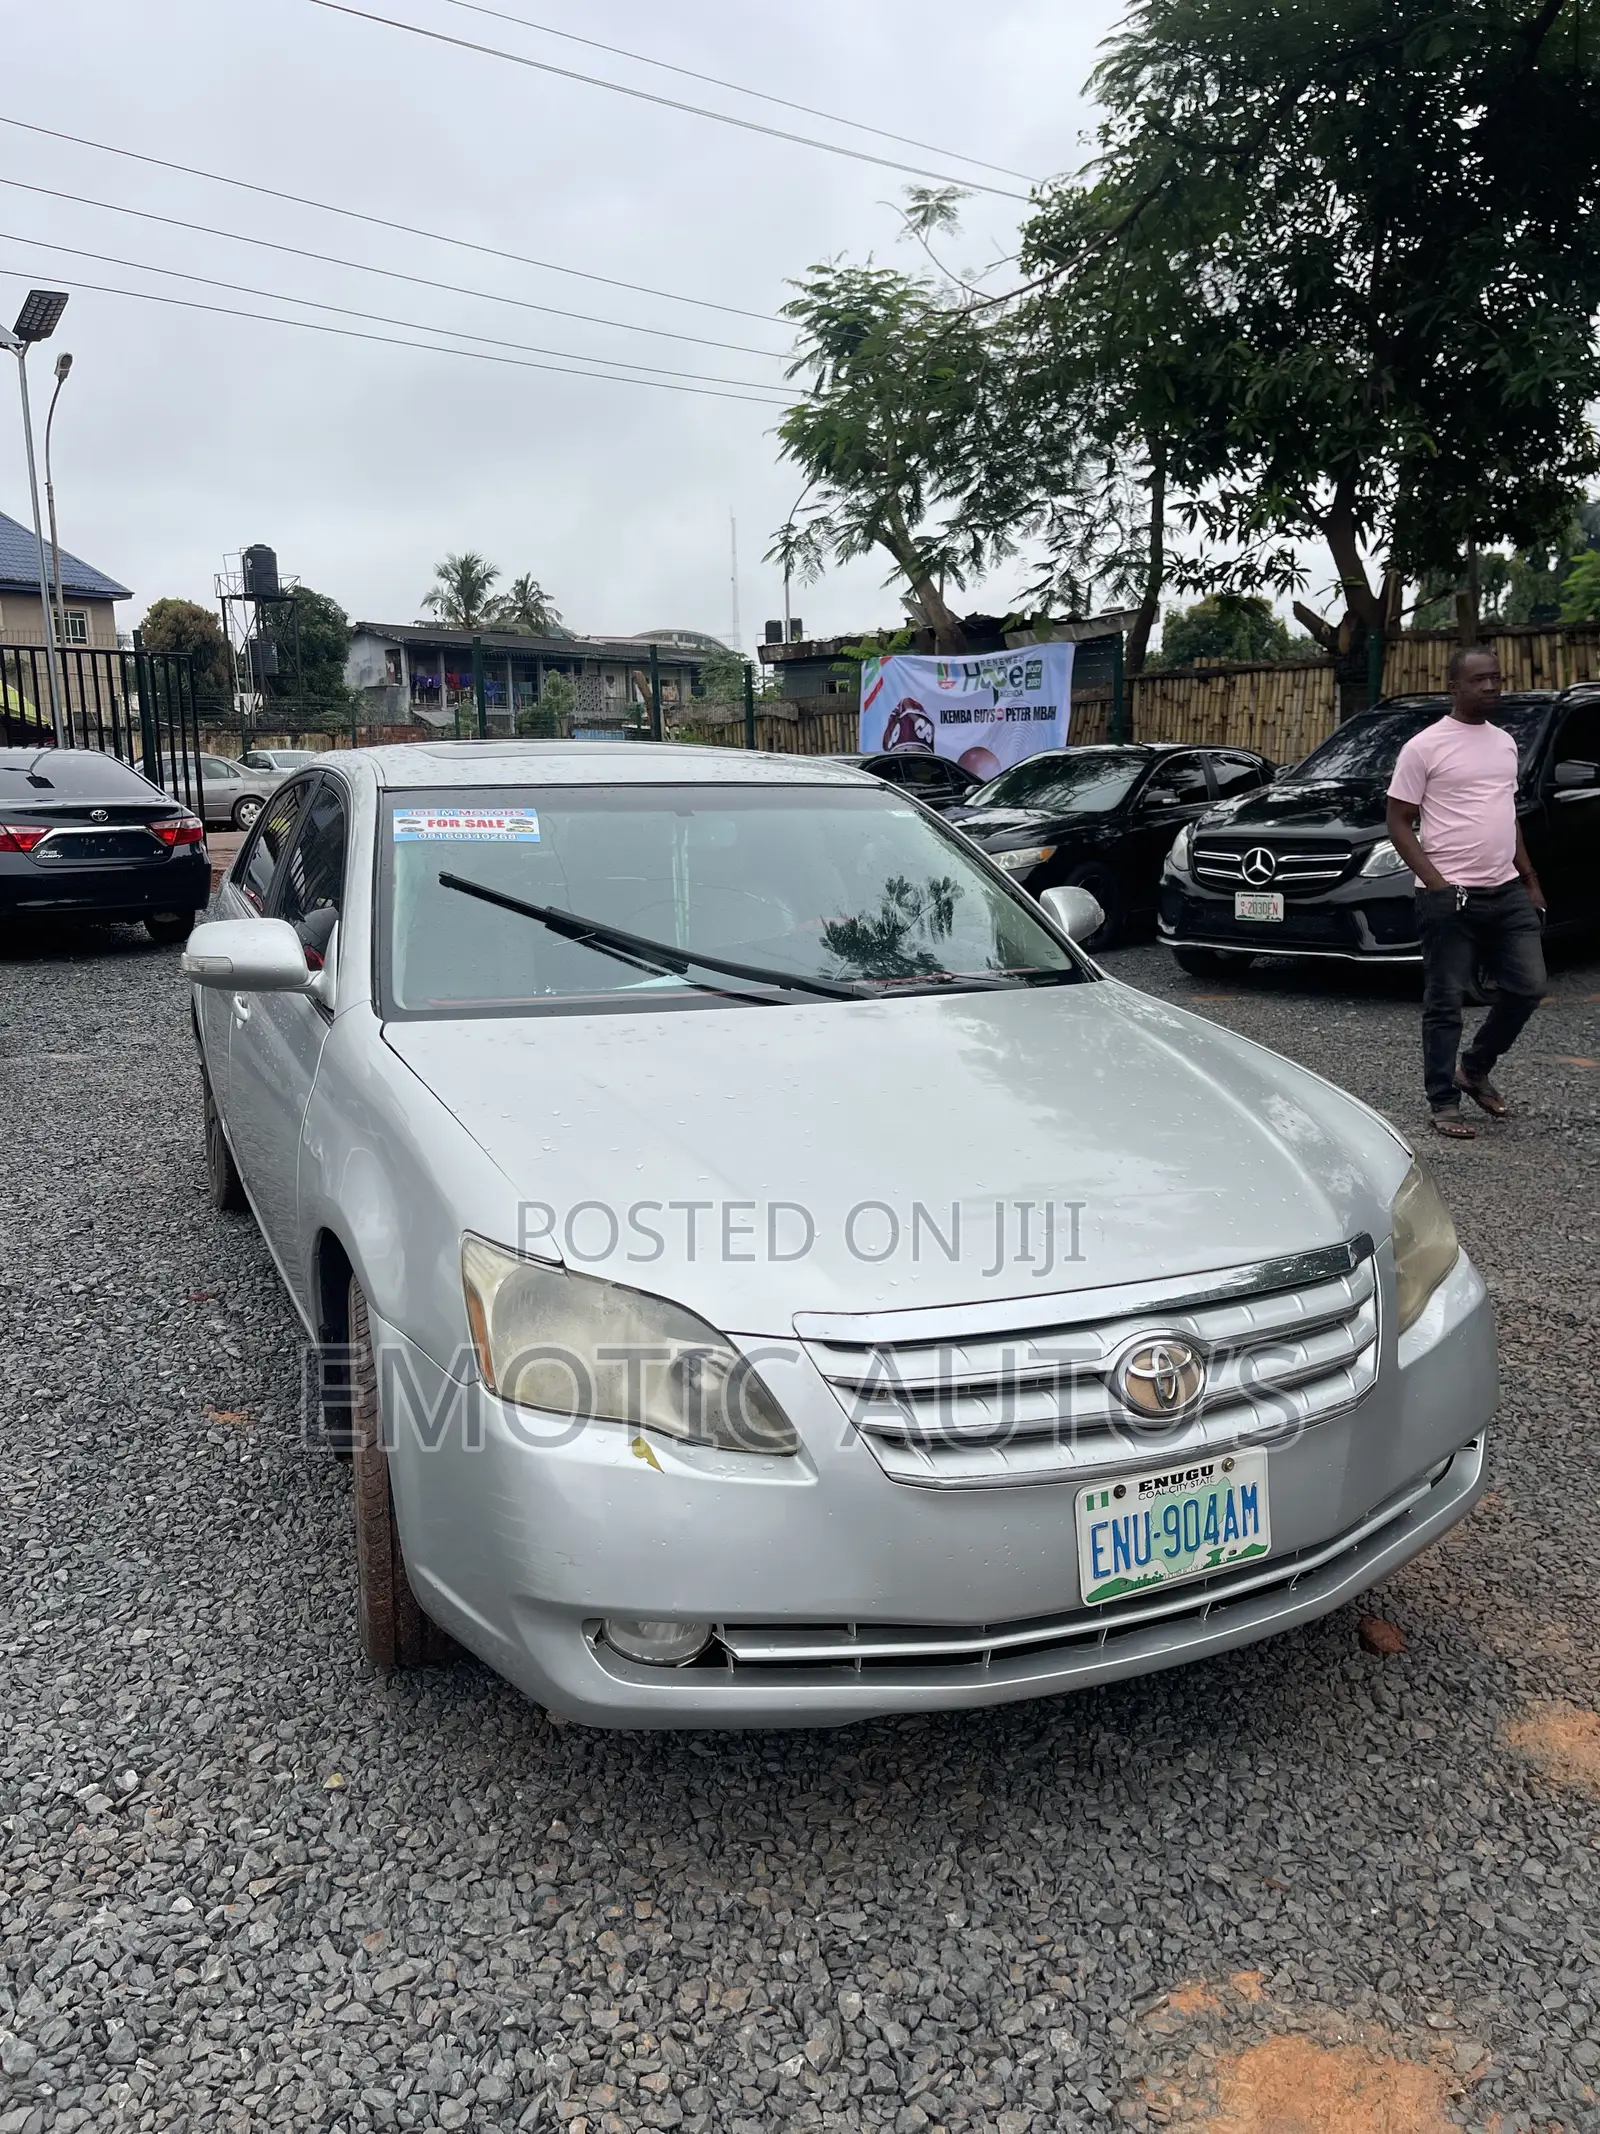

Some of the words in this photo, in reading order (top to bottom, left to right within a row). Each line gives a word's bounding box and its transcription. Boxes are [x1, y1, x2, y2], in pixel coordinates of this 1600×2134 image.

[940, 709, 972, 724] IKEMBA
[973, 709, 995, 723] GUYS
[1005, 707, 1031, 722] PETER
[427, 819, 460, 828] FOR
[464, 819, 506, 828] SALE
[1138, 1464, 1215, 1492] ENUGU
[1138, 1489, 1166, 1501] COAL
[1168, 1483, 1189, 1494] CITY
[1190, 1476, 1215, 1488] STATE
[1090, 1481, 1260, 1580] ENU-904AM
